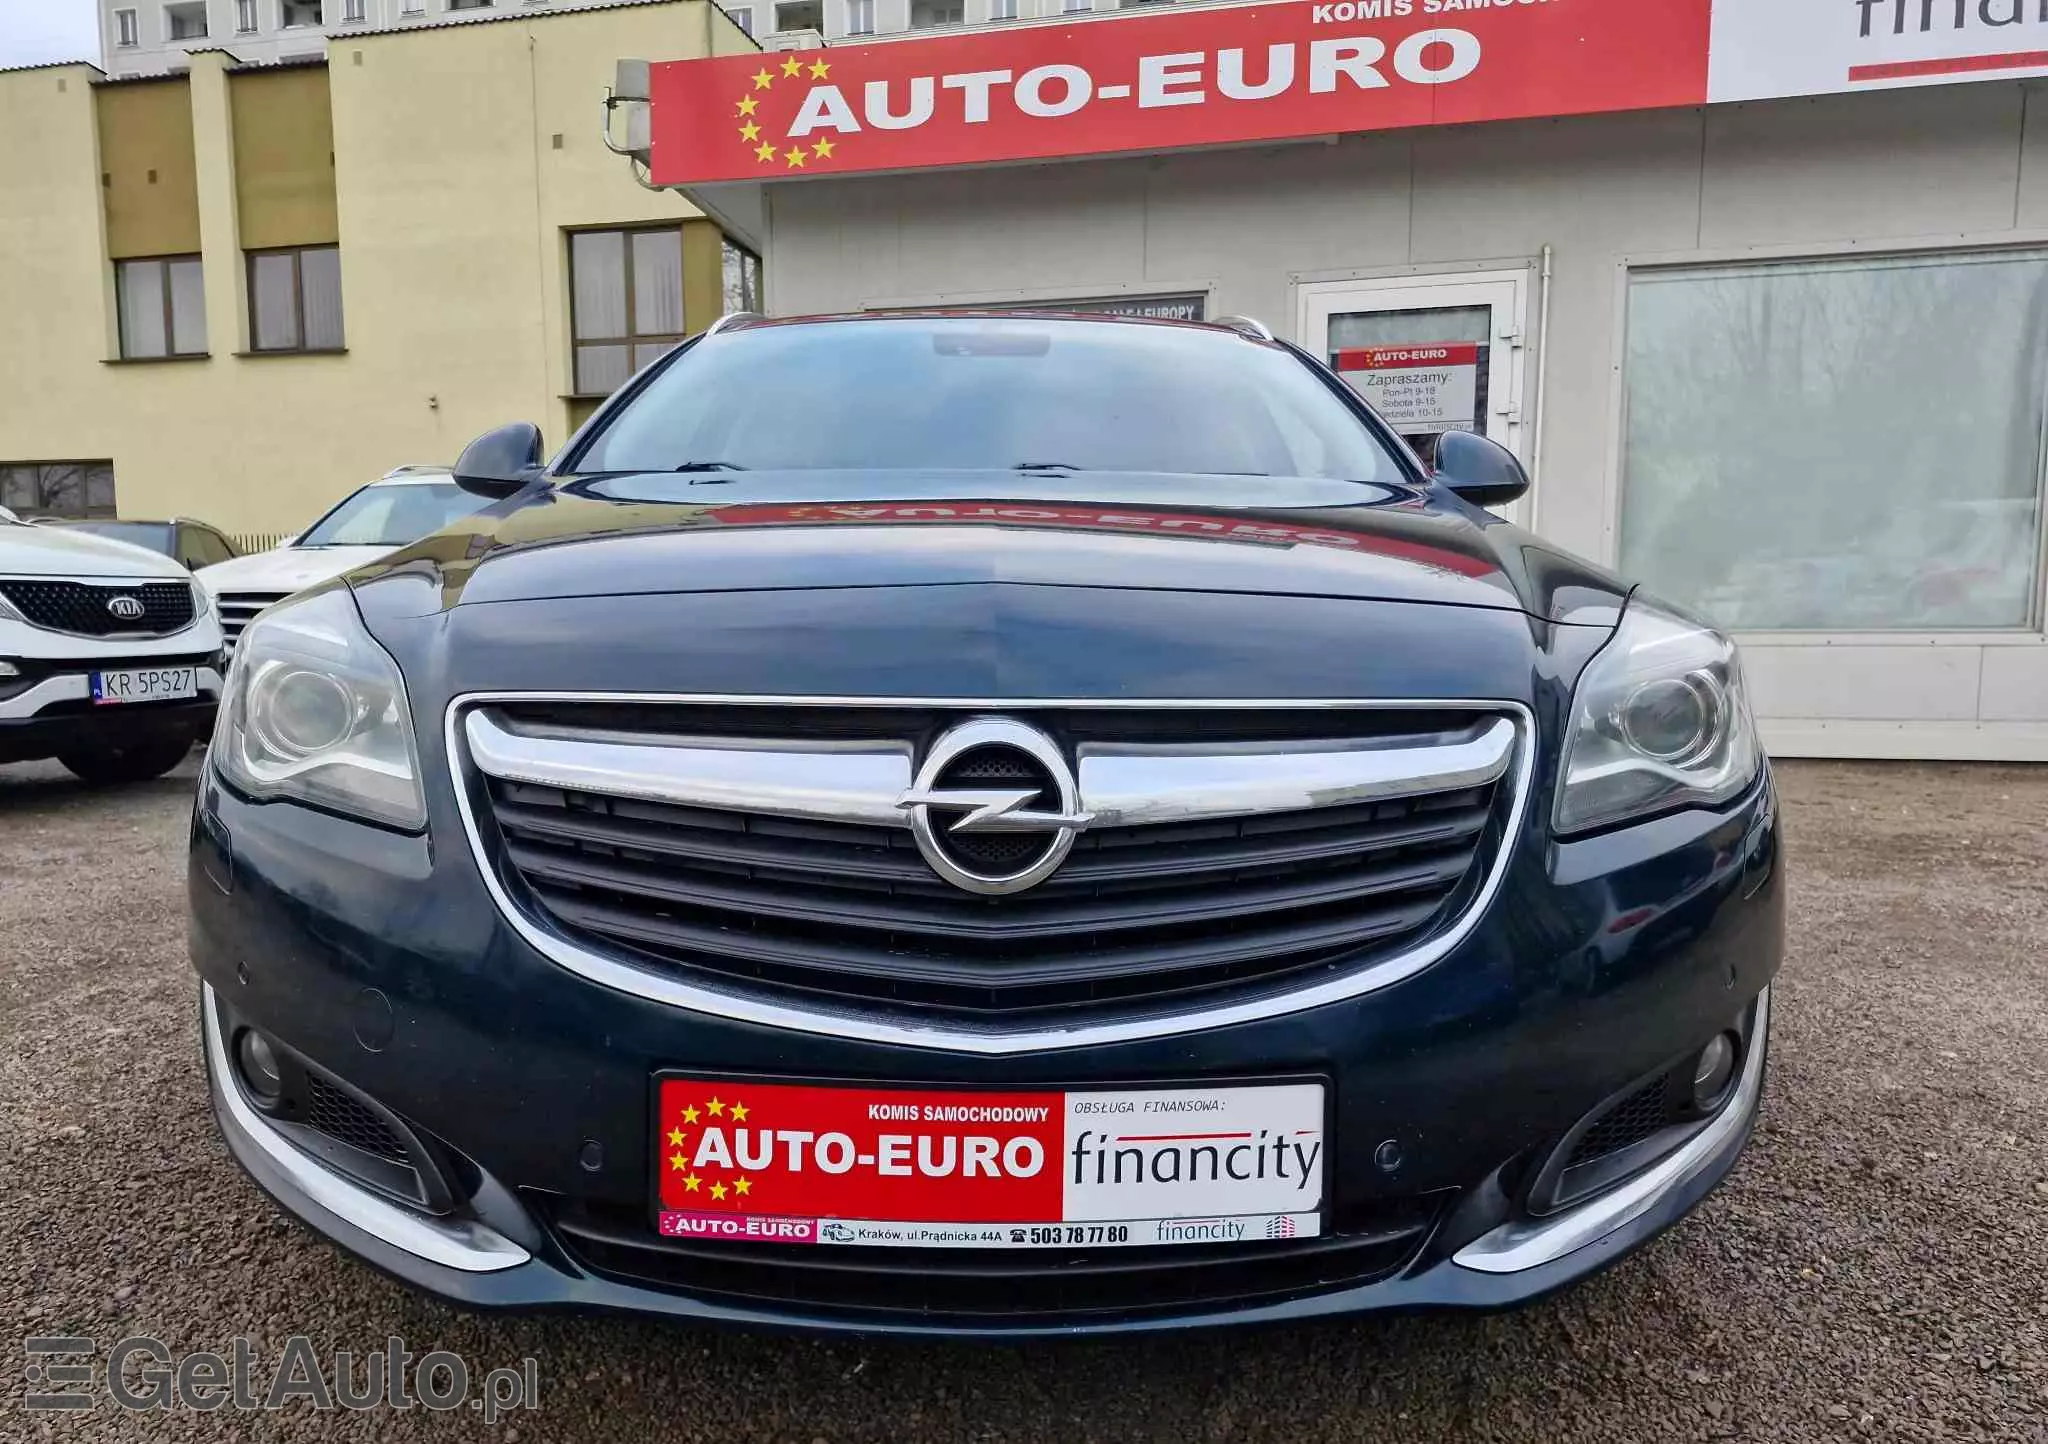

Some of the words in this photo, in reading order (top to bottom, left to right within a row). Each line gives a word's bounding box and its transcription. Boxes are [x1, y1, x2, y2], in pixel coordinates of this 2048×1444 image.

[1312, 0, 1413, 24] KOMIS
[787, 28, 1481, 138] AUTO-EURO
[1373, 349, 1448, 361] AUTO-EURO
[115, 602, 142, 615] KIA
[106, 673, 132, 696] KR
[138, 669, 191, 694] 5PS27
[868, 1104, 919, 1121] KOMIS
[924, 1105, 1049, 1123] SAMOCHODOWY
[1074, 1101, 1135, 1114] OBSŁUGA
[1143, 1100, 1226, 1113] FINANSOWA:
[692, 1126, 1045, 1178] AUTO-EURO
[1071, 1129, 1321, 1190] financity
[675, 1218, 811, 1238] AUTO-EURO
[858, 1229, 903, 1242] Kraków,
[980, 1231, 1002, 1242] 44A
[1030, 1227, 1062, 1244] 503
[1066, 1227, 1085, 1244] 78
[1088, 1226, 1105, 1243] 77
[1108, 1226, 1128, 1243] 80
[1156, 1218, 1246, 1242] financity
